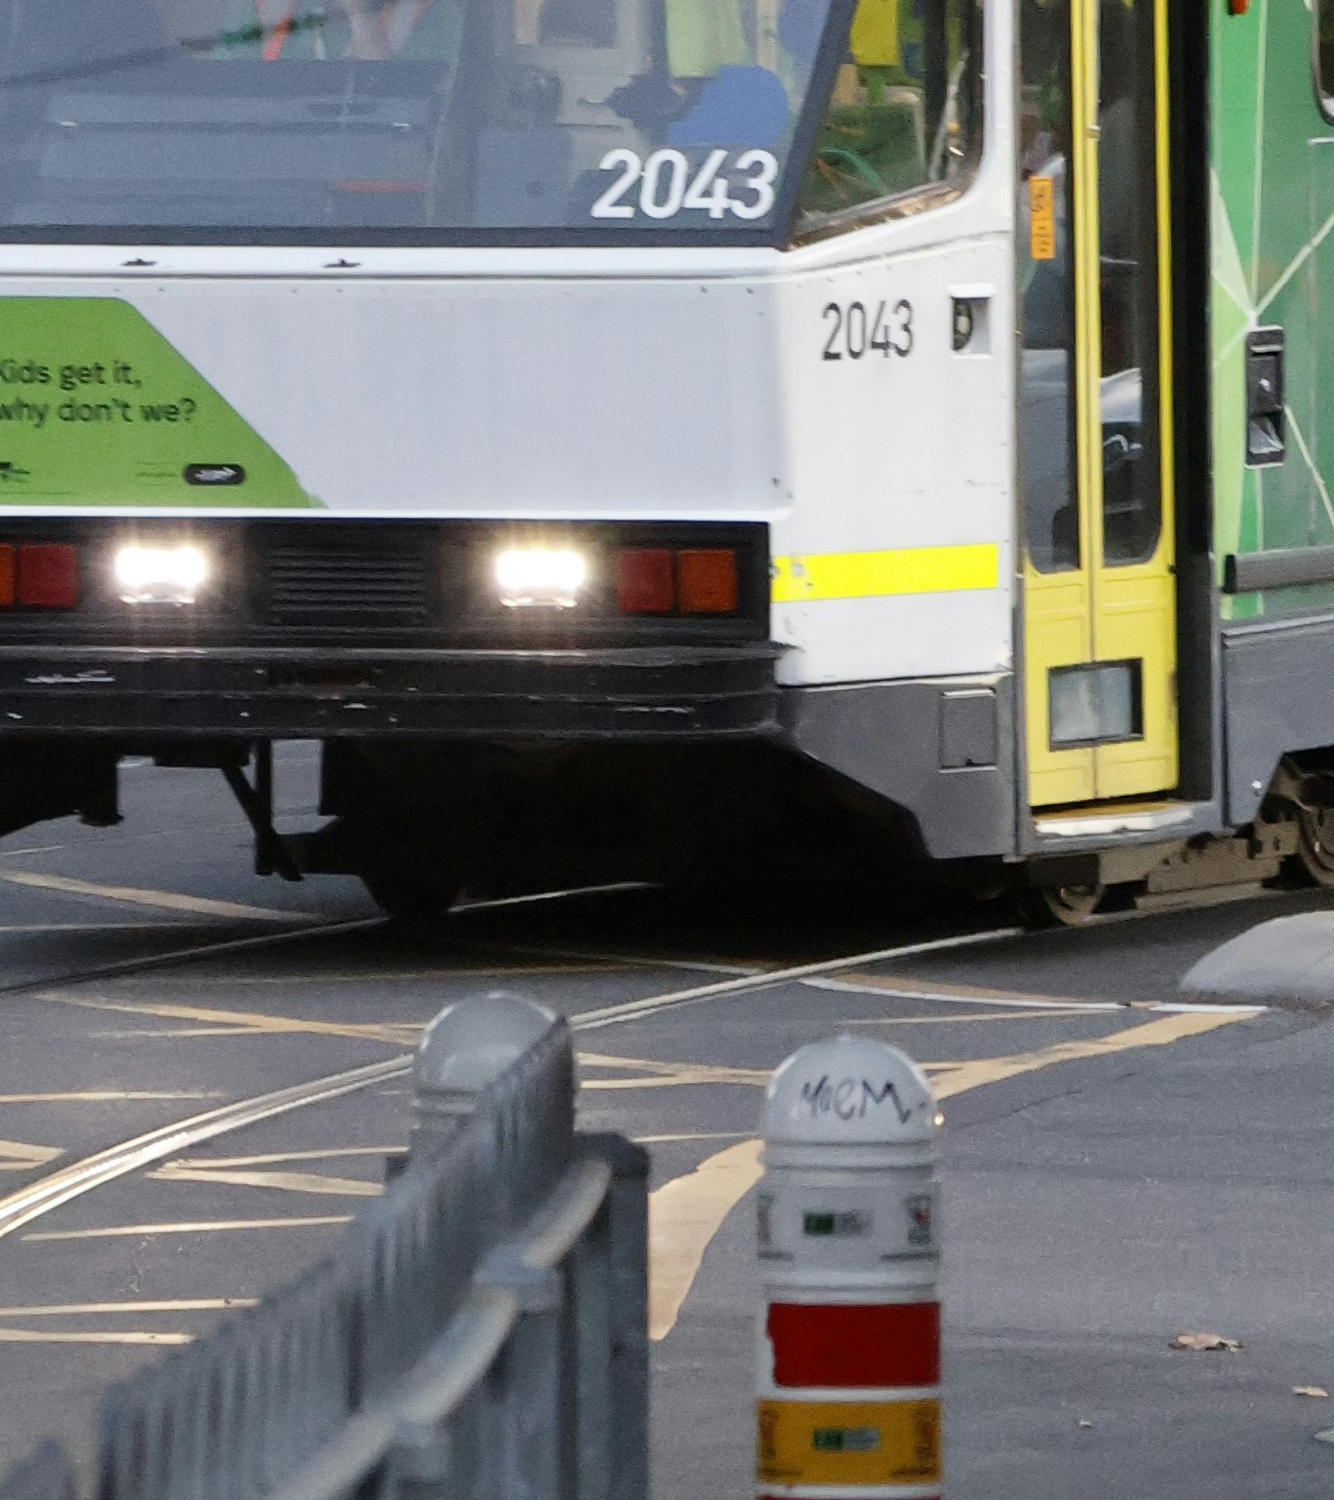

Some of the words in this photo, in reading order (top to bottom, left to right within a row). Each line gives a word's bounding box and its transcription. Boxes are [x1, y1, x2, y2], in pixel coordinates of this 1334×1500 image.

[590, 148, 779, 220] 2043
[821, 299, 915, 361] 2043
[59, 361, 107, 391] get
[112, 359, 143, 390] it,
[57, 396, 134, 423] don't
[139, 396, 198, 423] we?
